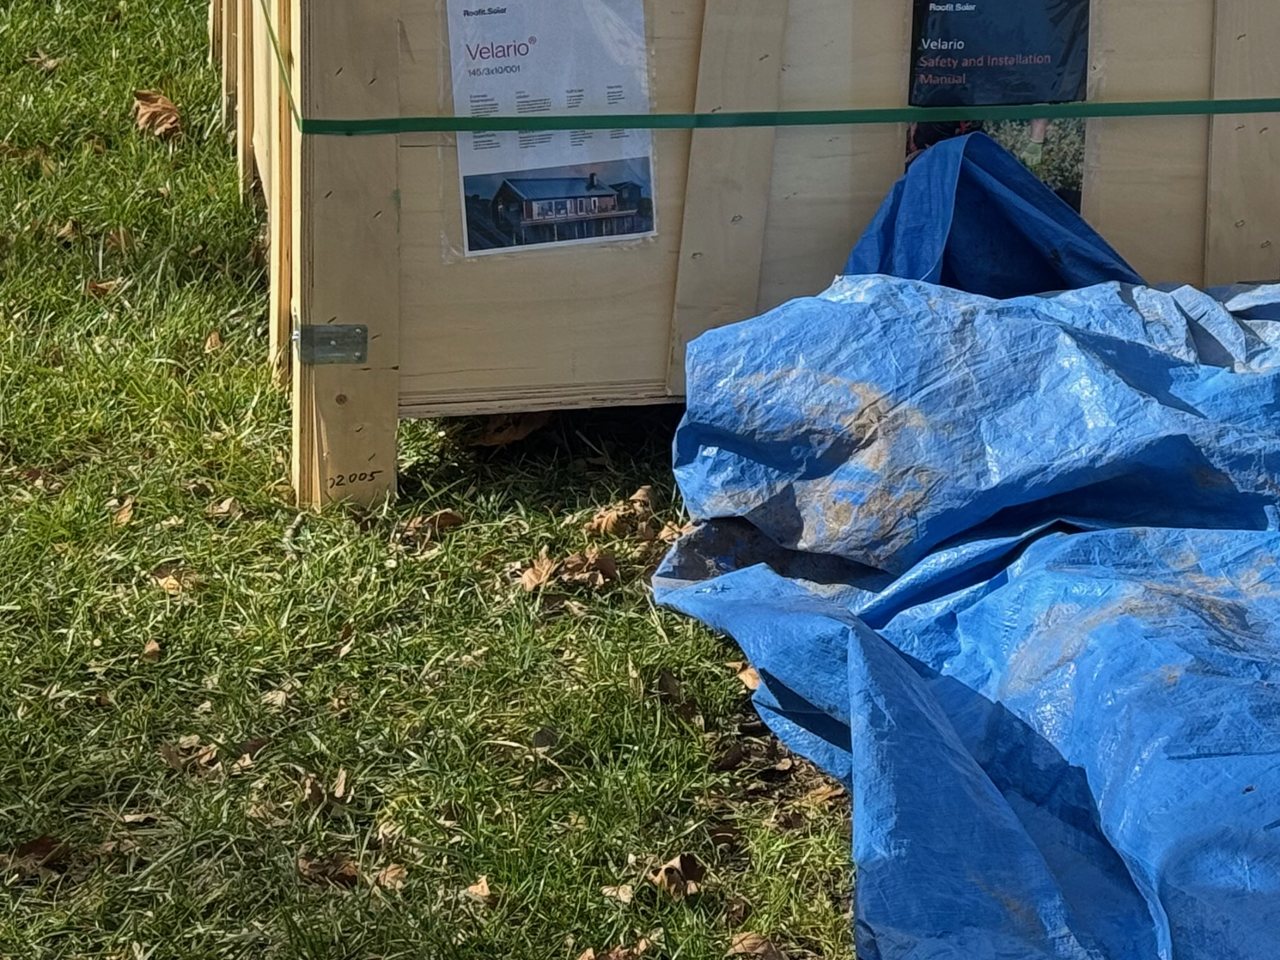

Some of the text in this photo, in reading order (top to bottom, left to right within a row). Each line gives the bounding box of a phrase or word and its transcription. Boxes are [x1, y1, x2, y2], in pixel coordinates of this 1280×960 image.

[929, 3, 976, 12] Roofit Solar
[921, 38, 965, 50] Velario
[919, 53, 1051, 68] Safety and Installation
[919, 73, 966, 85] Manual
